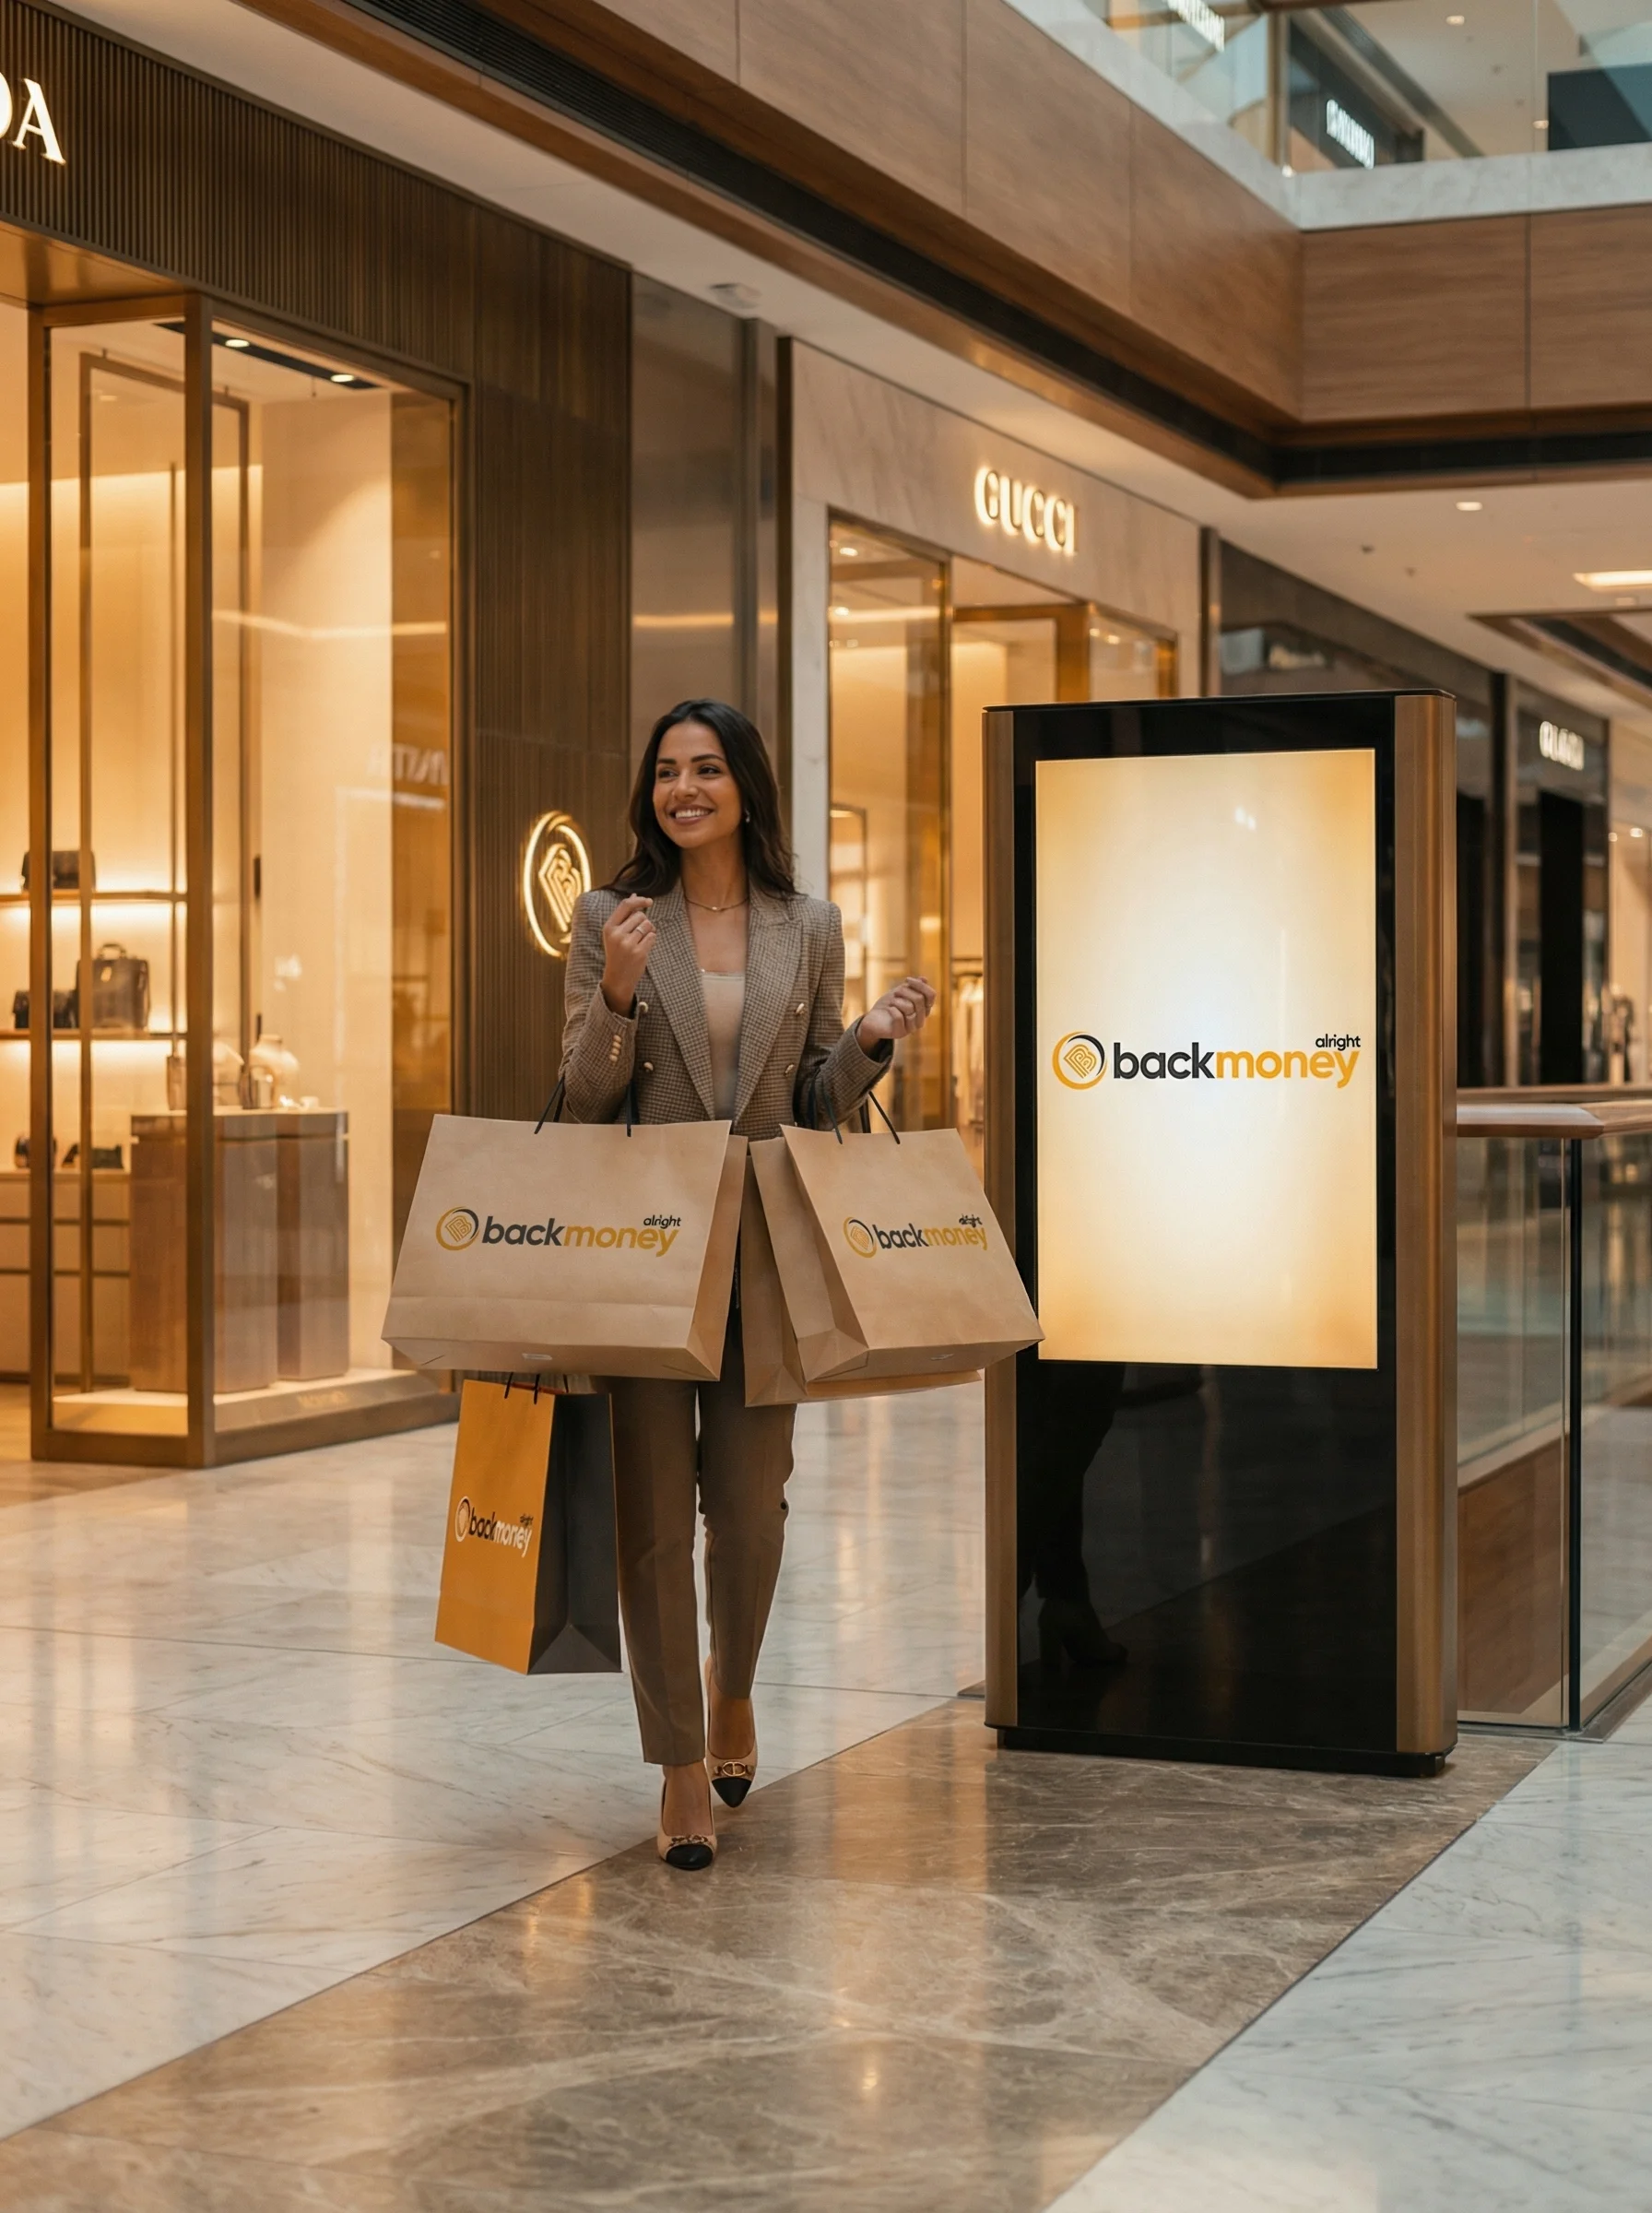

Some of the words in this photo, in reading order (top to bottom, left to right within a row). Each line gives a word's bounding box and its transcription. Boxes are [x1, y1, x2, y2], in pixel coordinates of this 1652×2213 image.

[974, 467, 1077, 557] GUCCI
[1315, 1033, 1361, 1051] alright
[1113, 1042, 1360, 1089] backmoney
[482, 1216, 678, 1257] backmoney
[643, 1214, 681, 1229] alright
[872, 1223, 988, 1250] backmoney
